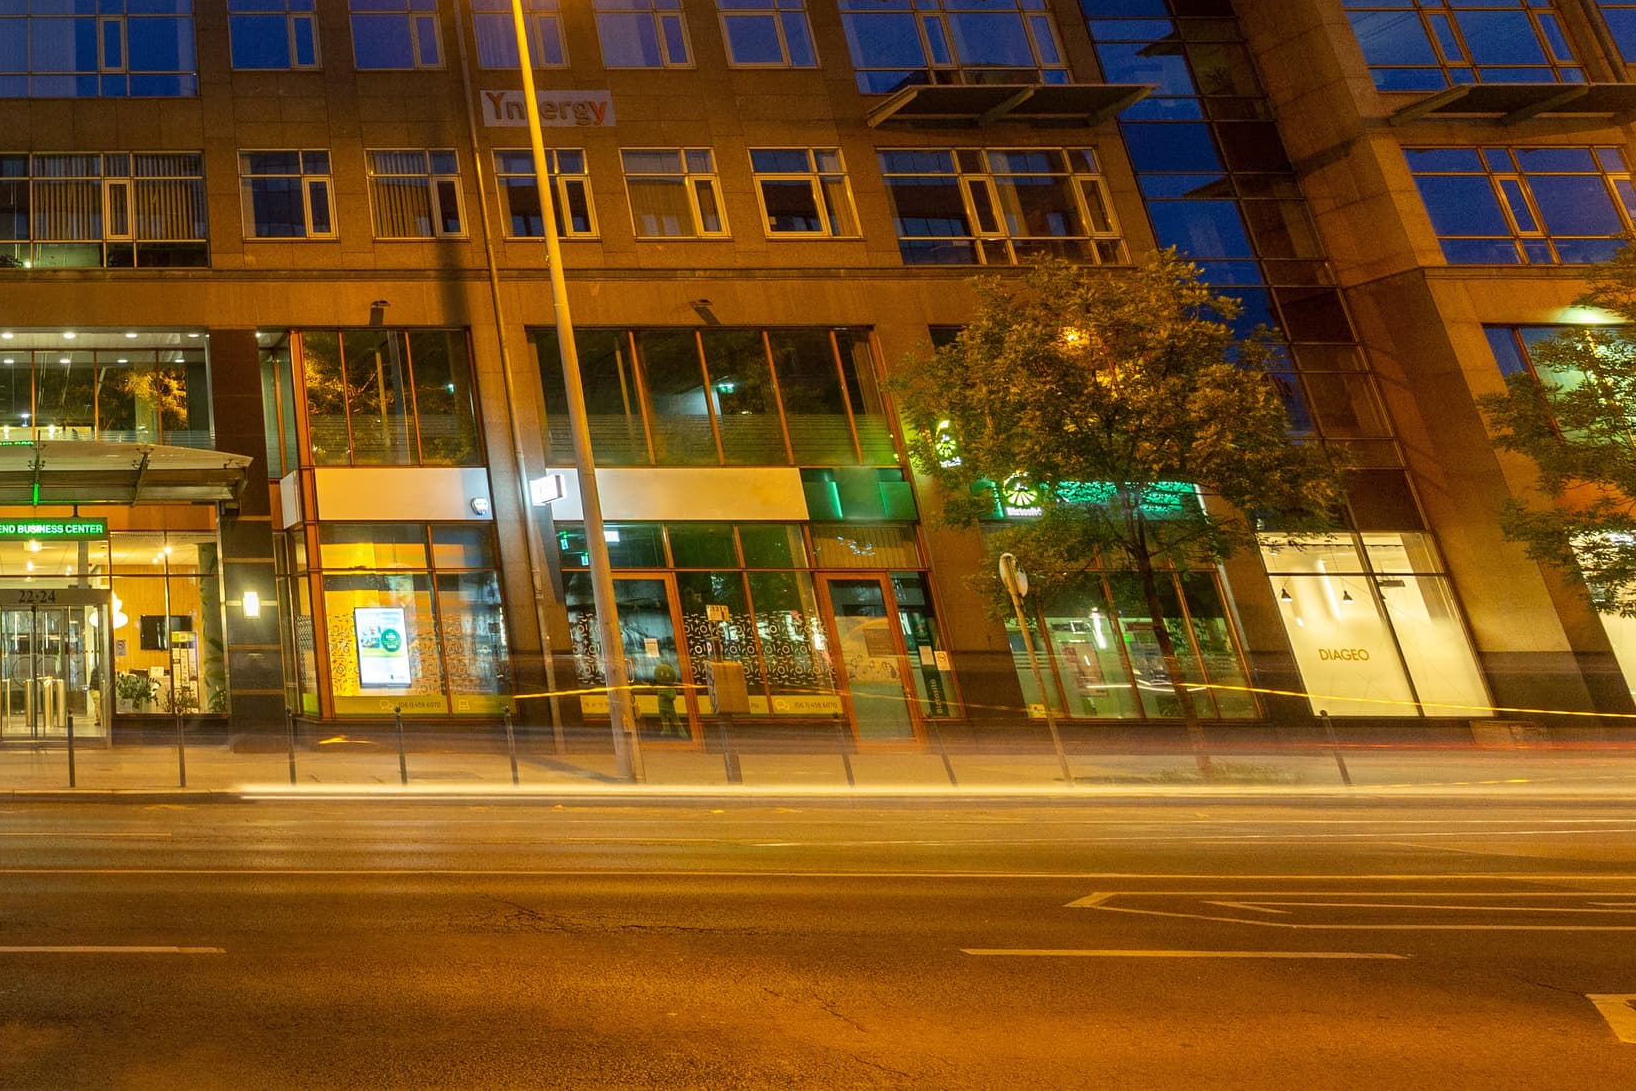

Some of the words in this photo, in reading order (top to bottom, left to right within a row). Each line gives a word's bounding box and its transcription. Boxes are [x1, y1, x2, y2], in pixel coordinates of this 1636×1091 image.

[486, 92, 608, 126] Ynergy
[17, 524, 64, 534] BUSINESS
[65, 524, 103, 534] CENTER
[1318, 649, 1370, 661] DIAGEO
